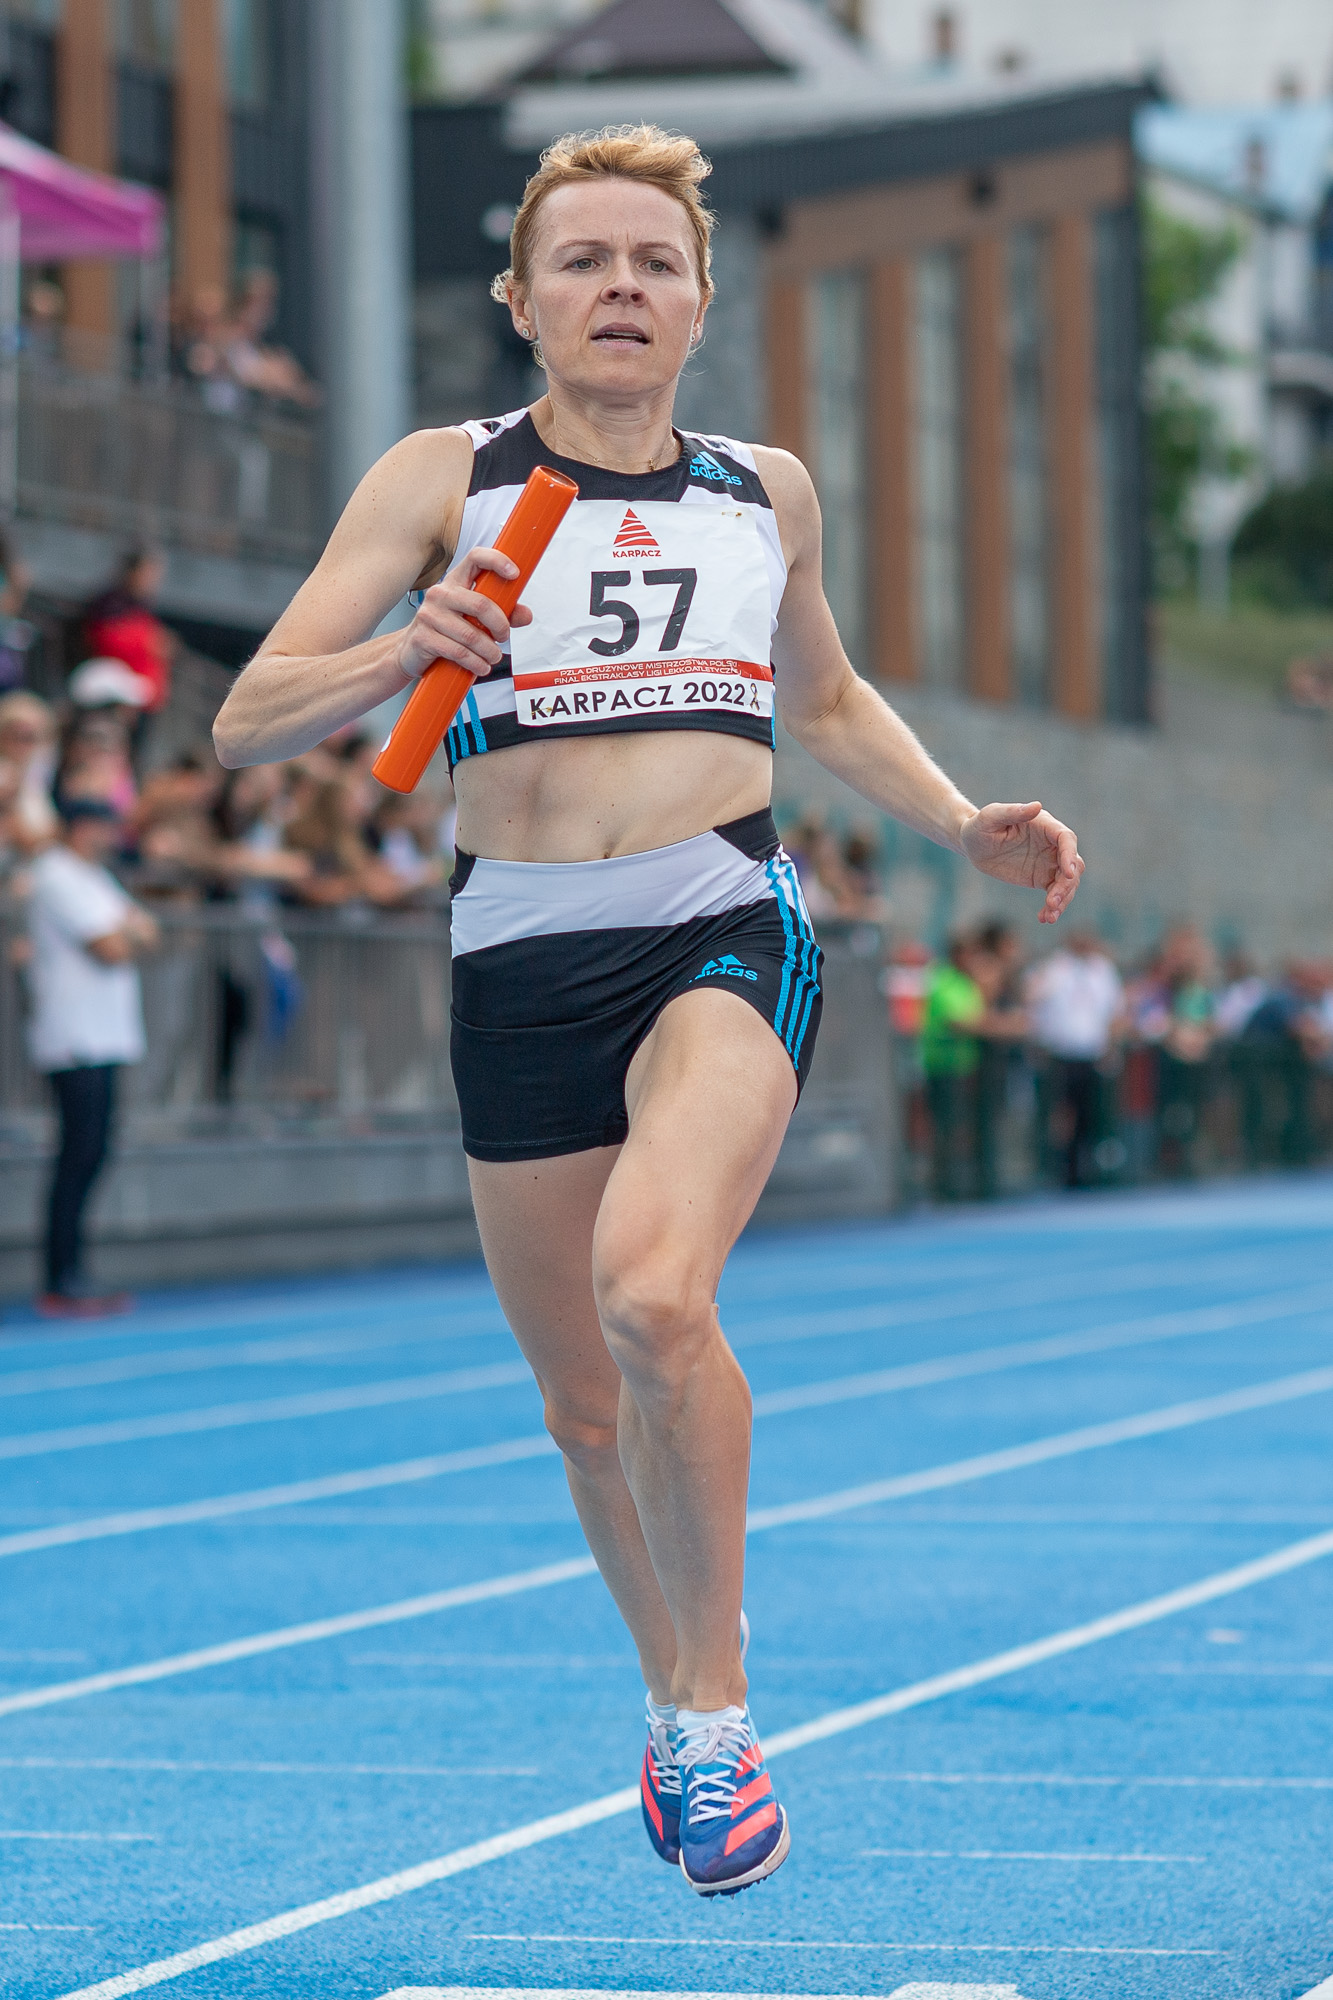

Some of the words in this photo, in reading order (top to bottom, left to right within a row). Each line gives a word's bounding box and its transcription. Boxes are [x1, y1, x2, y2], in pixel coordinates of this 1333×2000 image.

[612, 549, 662, 558] KARPACZ
[587, 567, 698, 657] 57
[560, 668, 584, 677] PZLA
[645, 659, 708, 670] MISTRZOSTWA
[580, 670, 645, 683] EKSTRAKLASY
[646, 669, 662, 677] LIGI
[529, 684, 674, 720] KARPACZ
[683, 681, 746, 706] 2022
